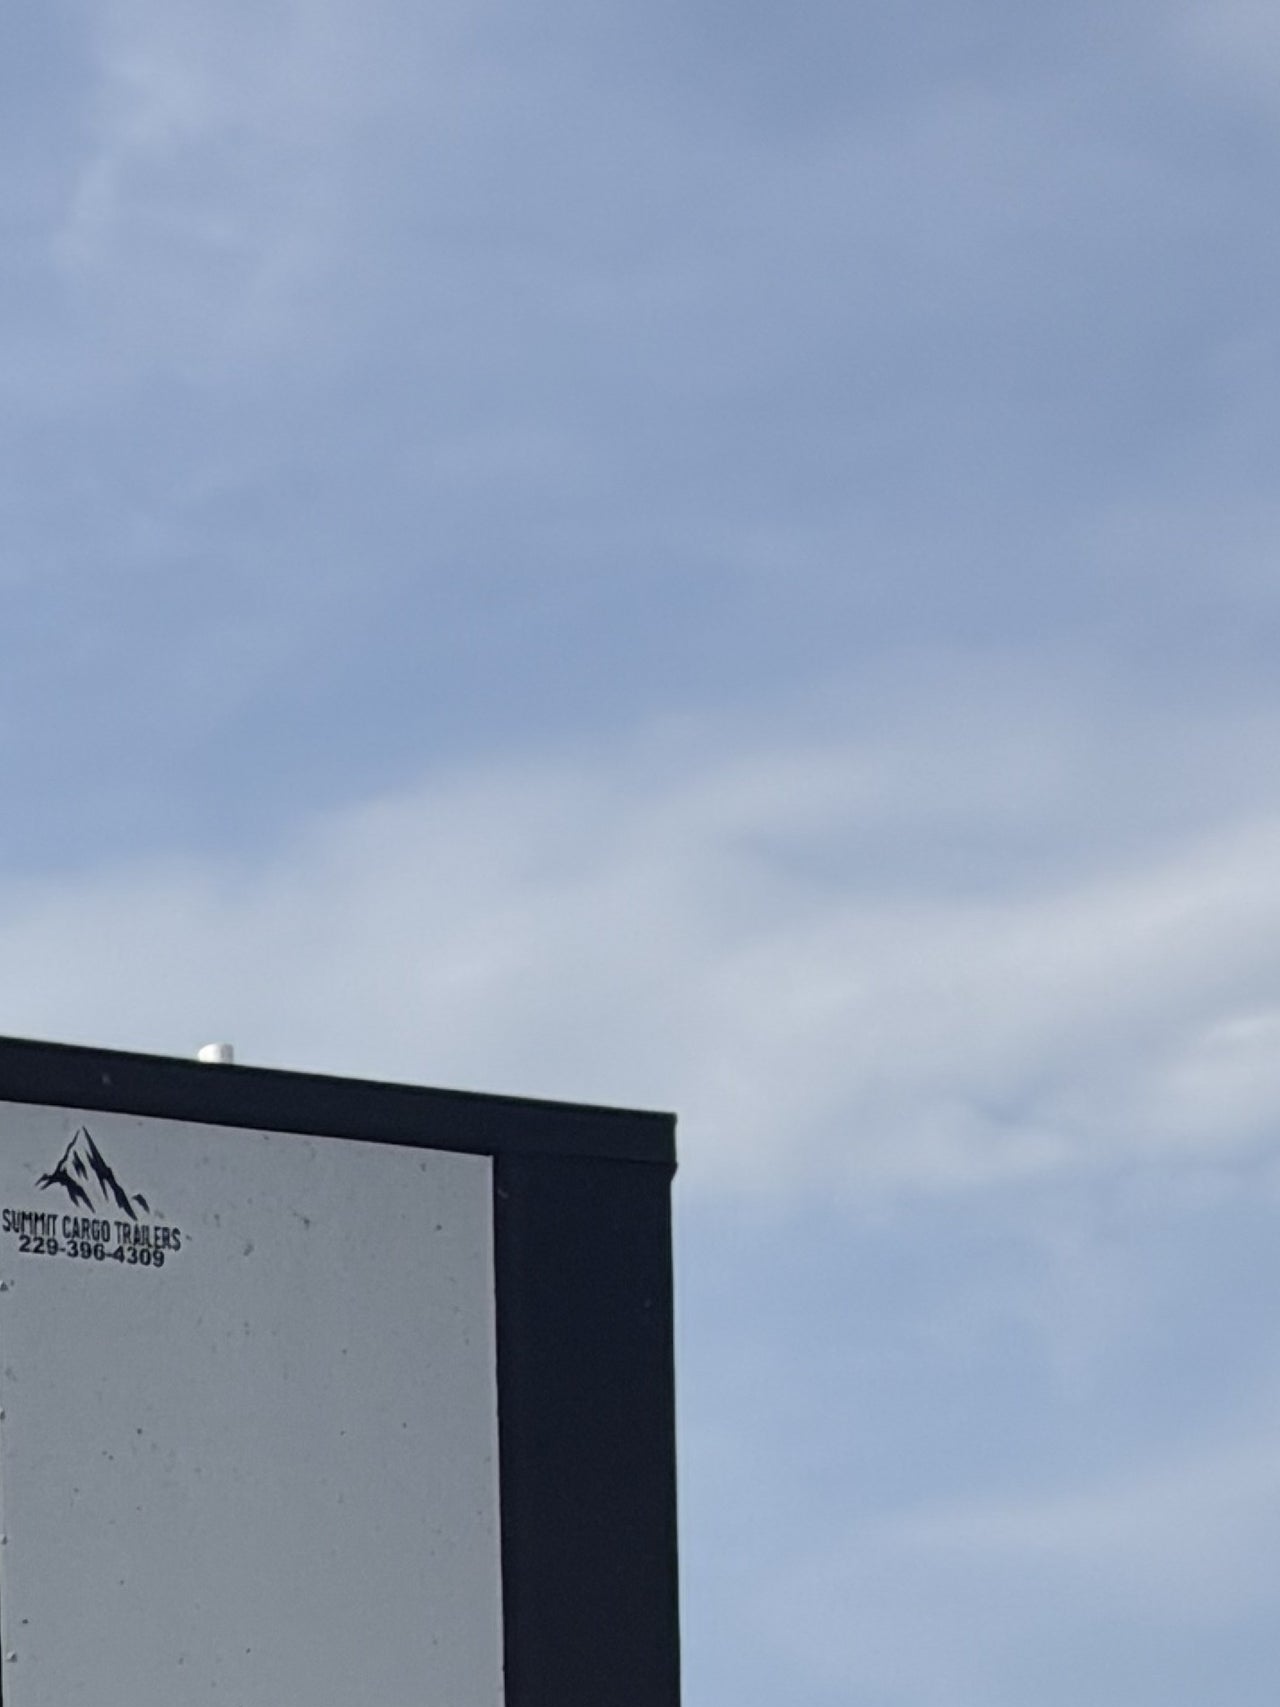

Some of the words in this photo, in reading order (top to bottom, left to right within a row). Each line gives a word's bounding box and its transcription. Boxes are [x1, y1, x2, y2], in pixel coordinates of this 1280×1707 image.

[2, 1208, 58, 1236] SUMMIT
[62, 1215, 111, 1242] CARGO
[114, 1221, 181, 1251] TRAILERS
[18, 1235, 165, 1268] 229-396-4309
